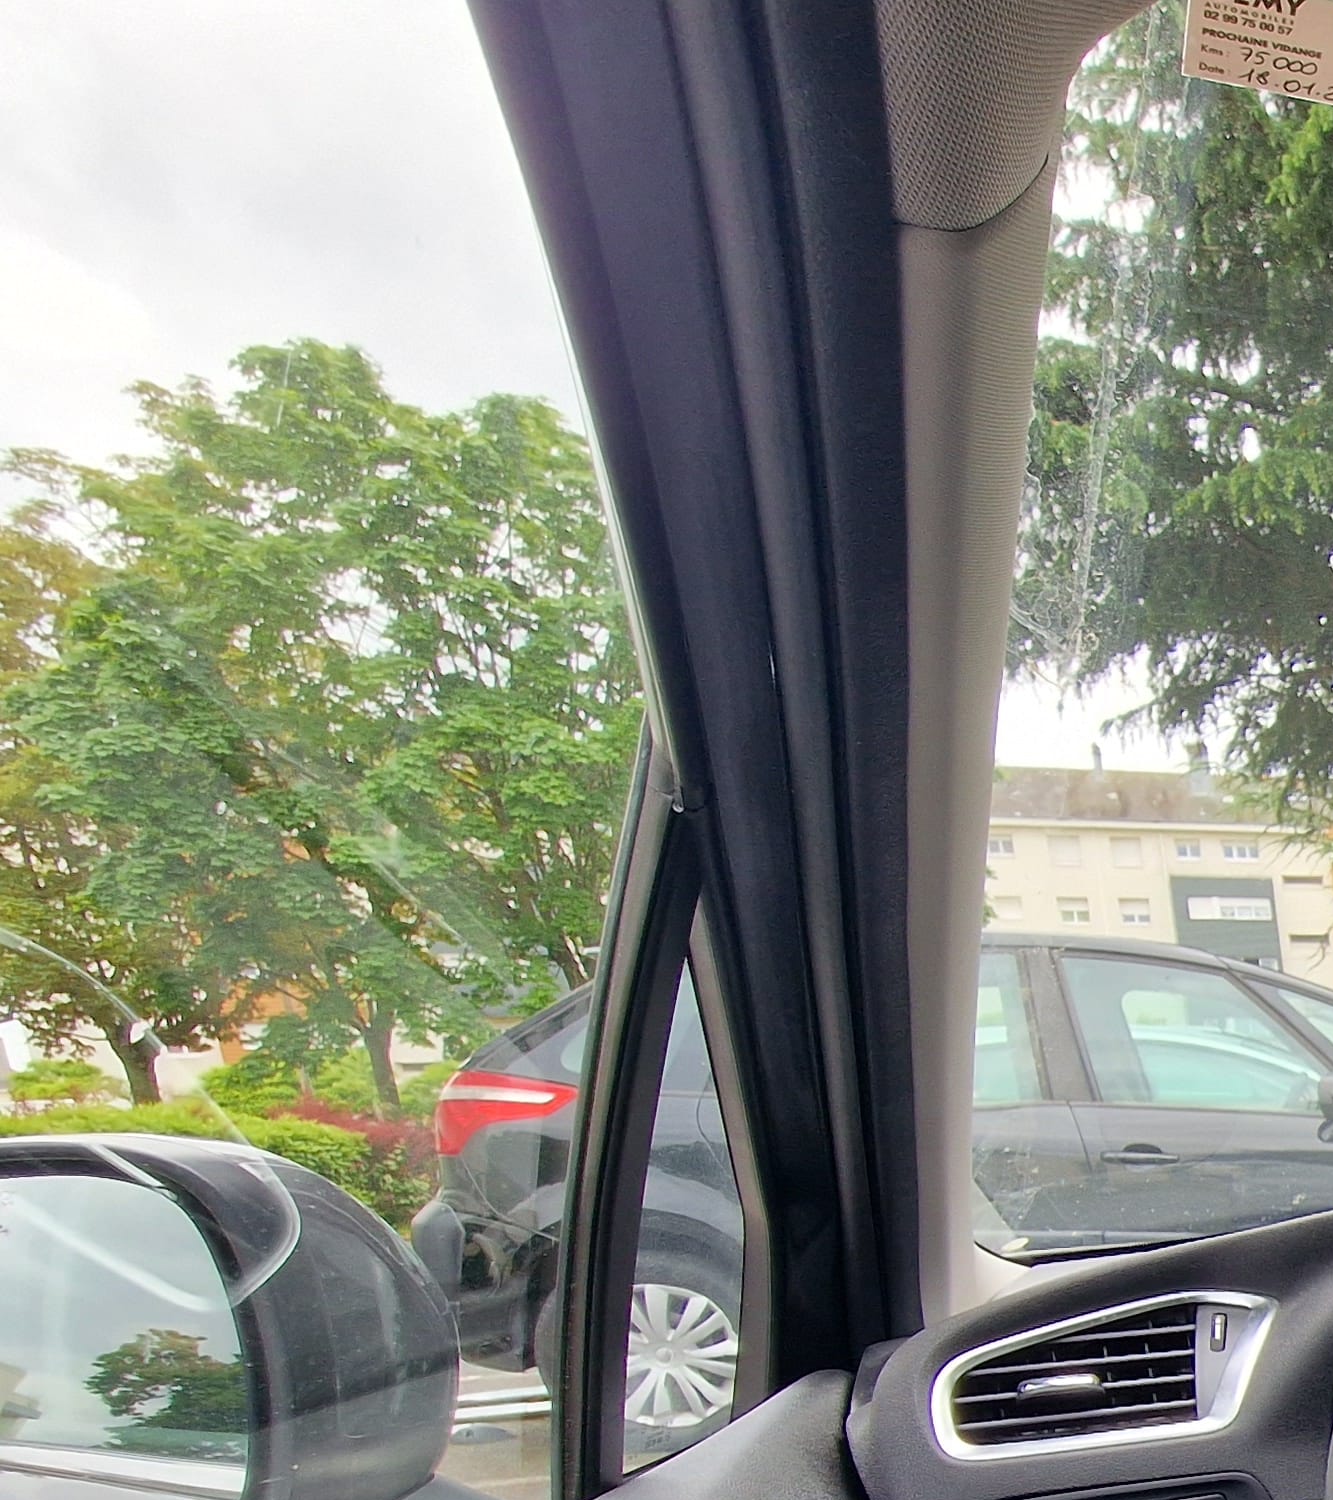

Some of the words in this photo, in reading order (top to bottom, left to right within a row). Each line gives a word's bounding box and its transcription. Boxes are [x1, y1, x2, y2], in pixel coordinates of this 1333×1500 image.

[1203, 9, 1220, 20] 02
[1222, 13, 1239, 24] 99
[1241, 17, 1256, 28] 75
[1259, 22, 1275, 32] 00
[1277, 26, 1293, 36] 57
[1205, 2, 1295, 25] AUTOMOBILES
[1202, 27, 1269, 48] PROCHAINE
[1272, 41, 1322, 60] VIDANGE
